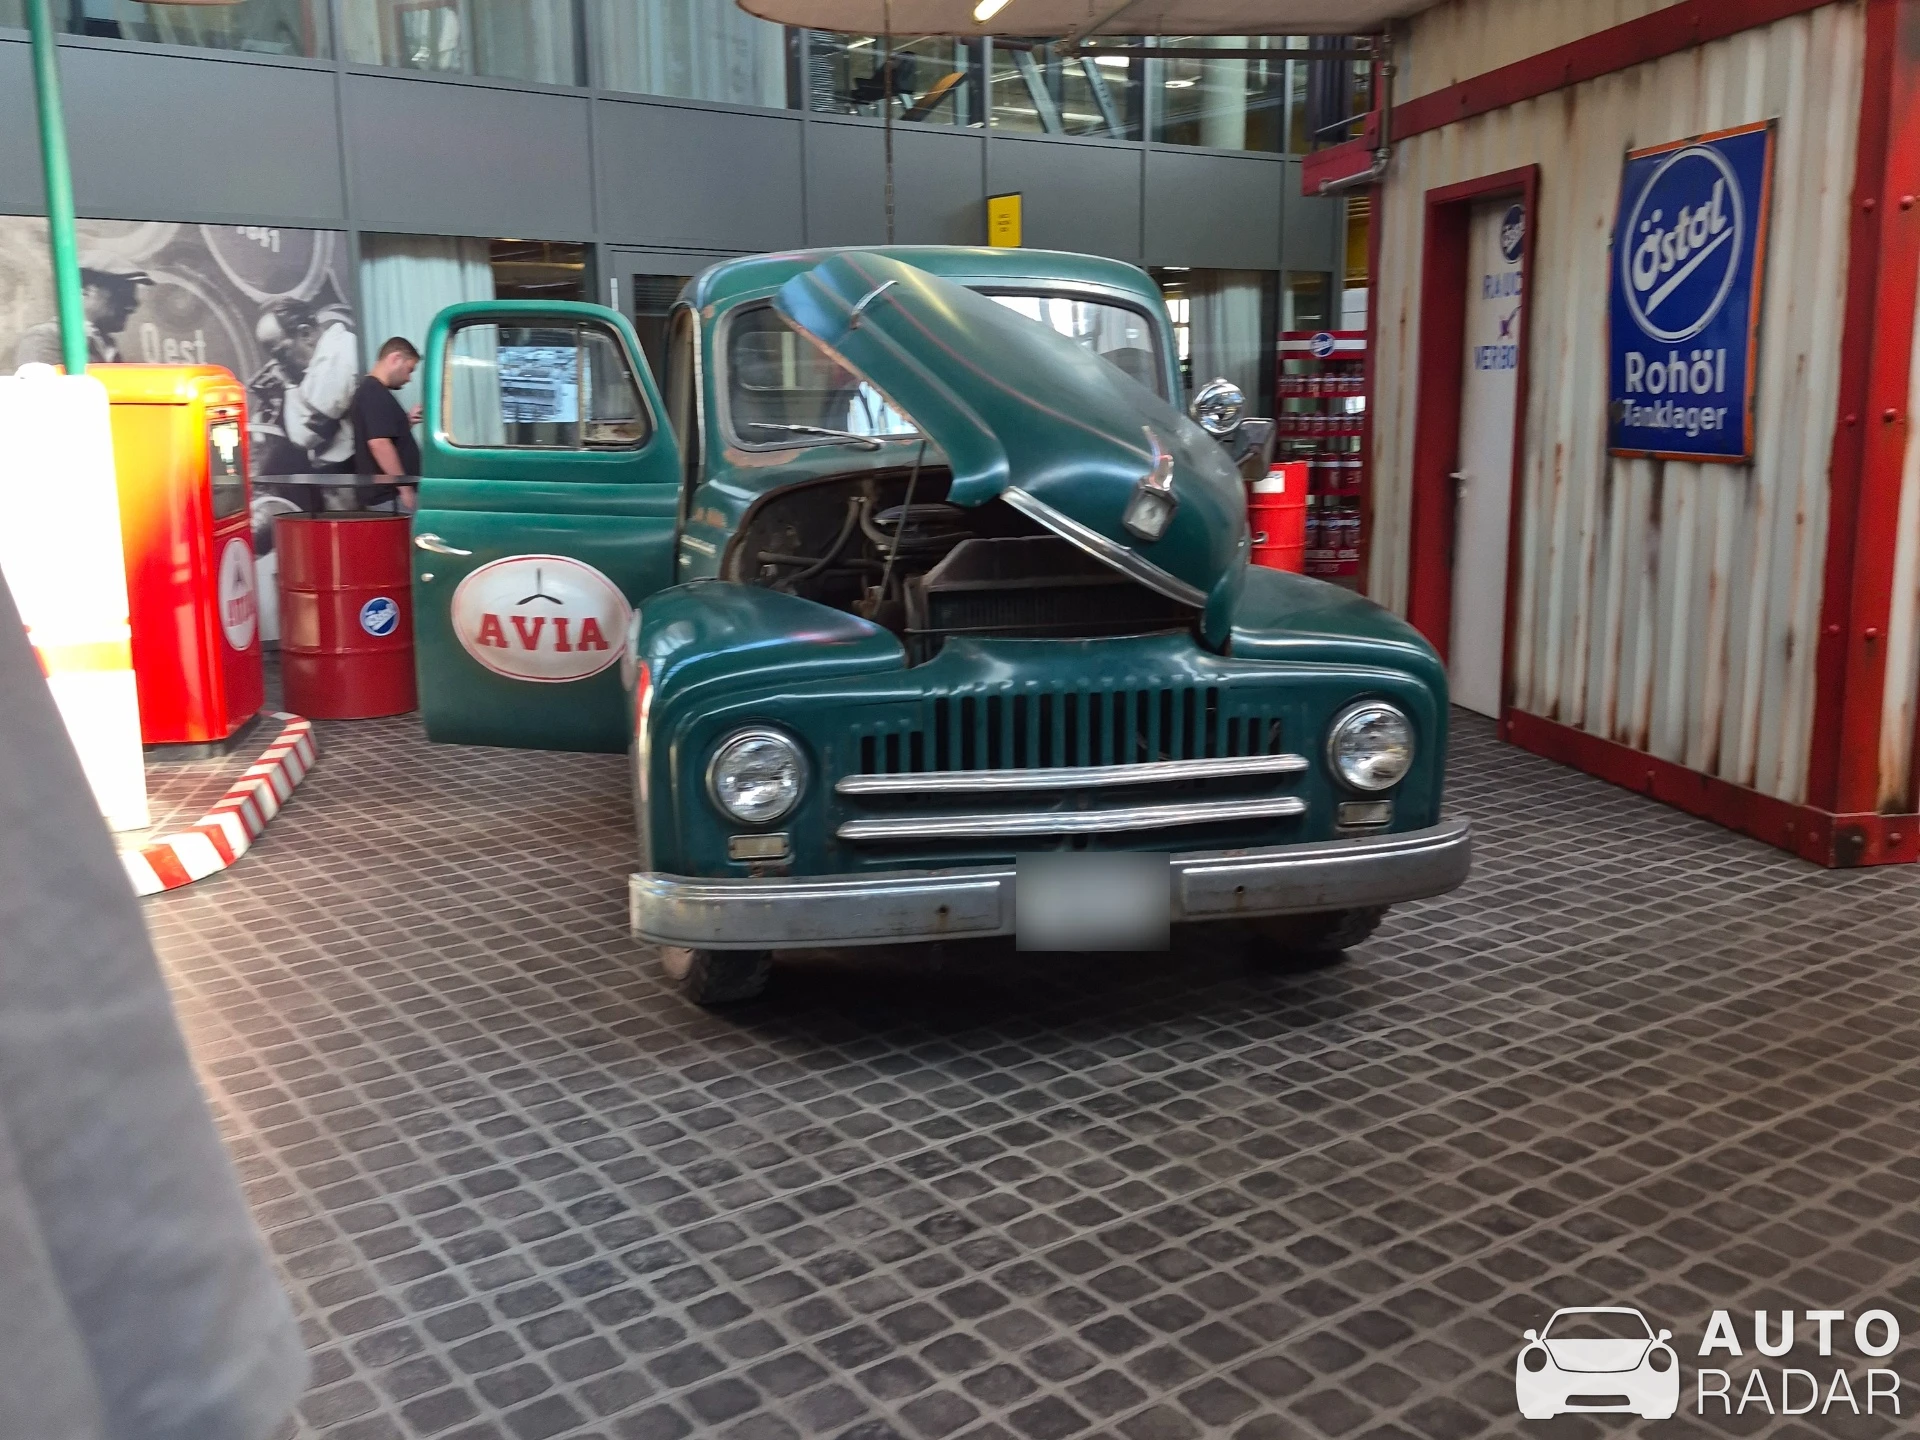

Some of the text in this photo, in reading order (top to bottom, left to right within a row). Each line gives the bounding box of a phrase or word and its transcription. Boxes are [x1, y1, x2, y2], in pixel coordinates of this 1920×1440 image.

[1624, 348, 1727, 395] Rohöl
[1622, 398, 1728, 437] Tanklager
[475, 612, 610, 653] AVIA
